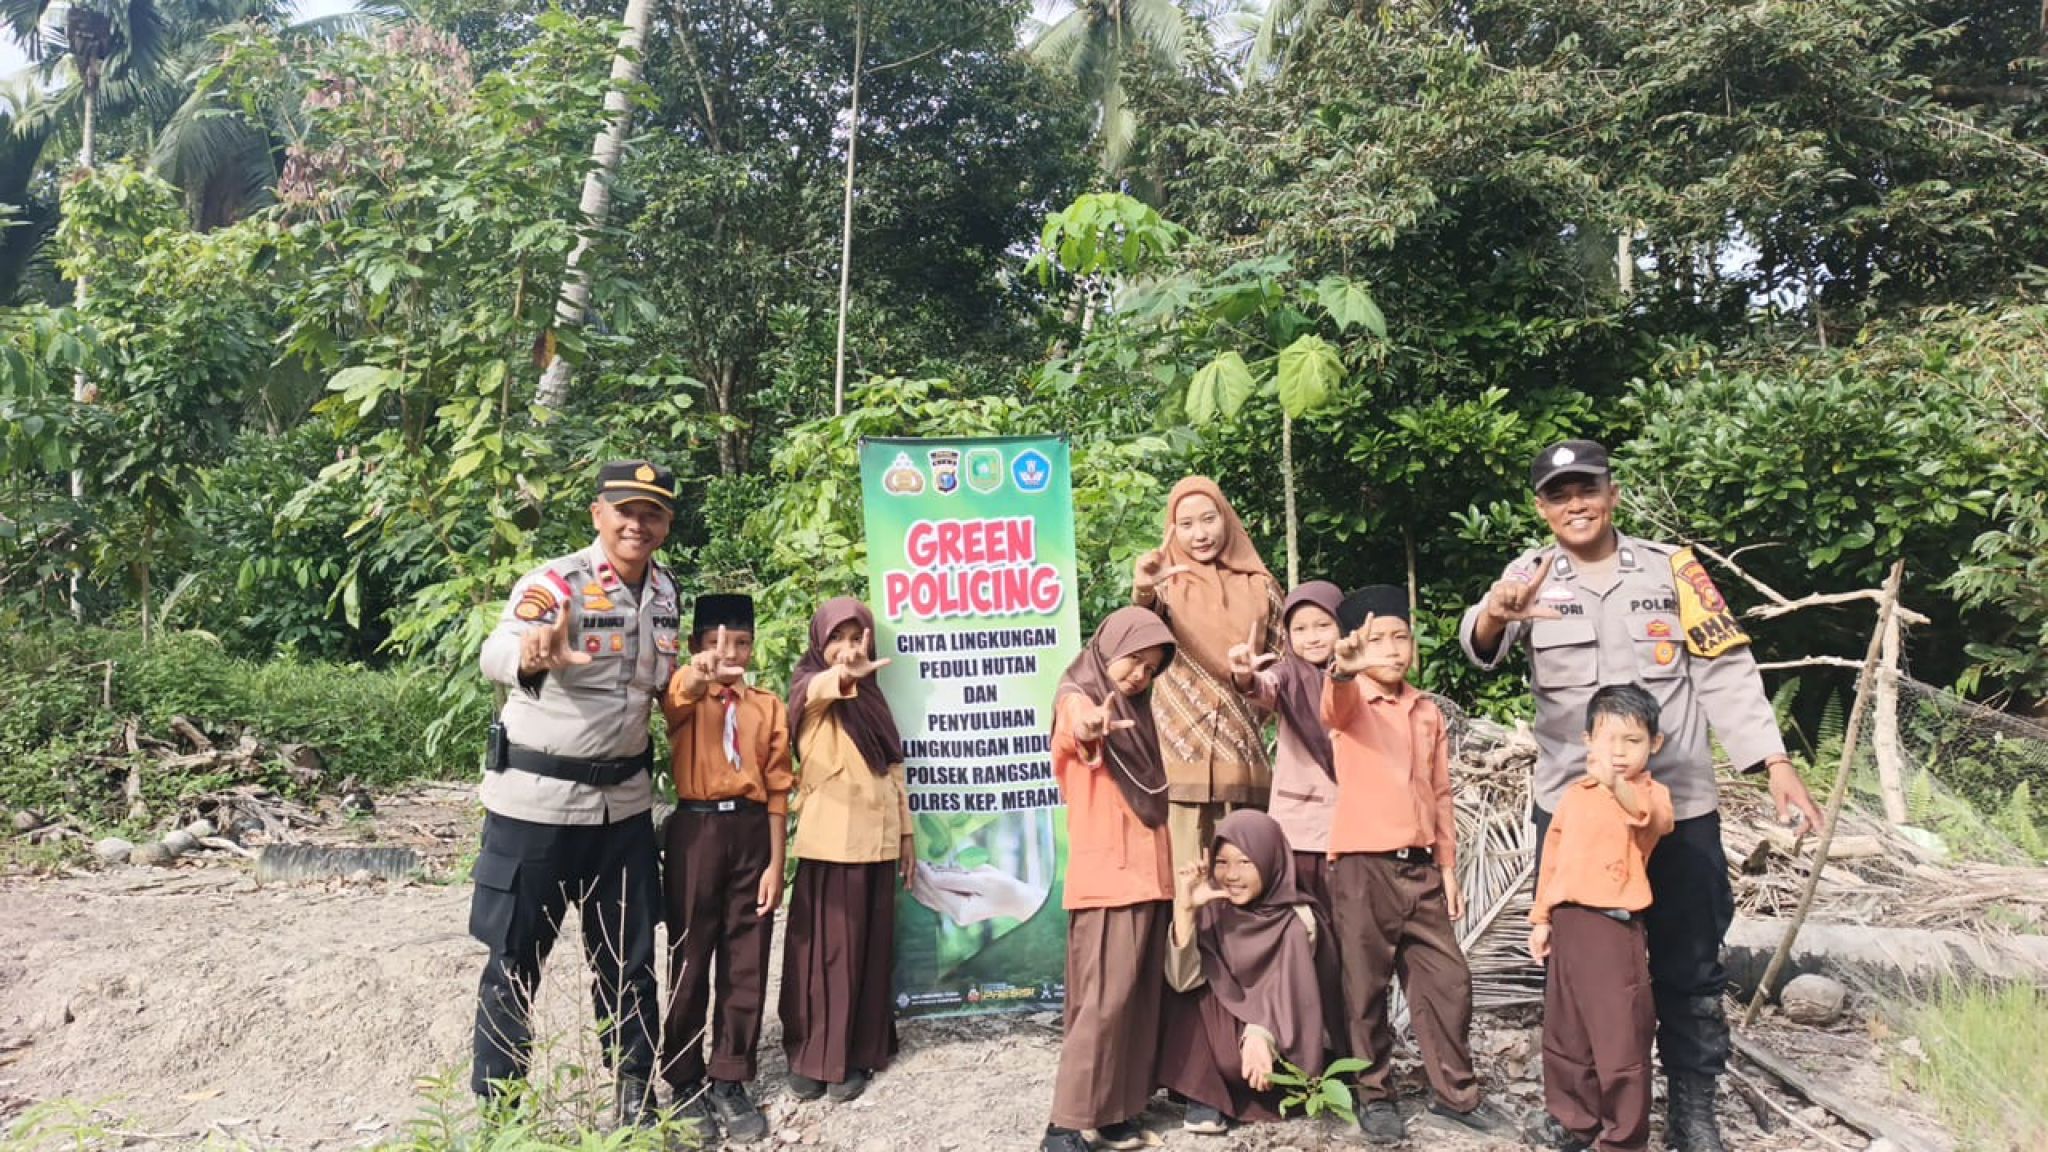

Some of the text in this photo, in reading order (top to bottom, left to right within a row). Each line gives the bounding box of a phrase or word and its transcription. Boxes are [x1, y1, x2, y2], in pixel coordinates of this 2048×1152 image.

[905, 517, 1035, 567] GREEN
[885, 566, 1062, 618] POLICING
[896, 628, 1057, 653] CINTA LINGKUNGAN
[920, 655, 1036, 679] PEDULI HUTAN
[963, 684, 998, 705] DAN
[927, 708, 1035, 732] PENYULUHAN
[902, 735, 1052, 759] LINGKUNGAN HIDU
[906, 761, 1052, 785] POLSEK RANGSAN
[908, 787, 1060, 812] OLRES KEP. MERAN
